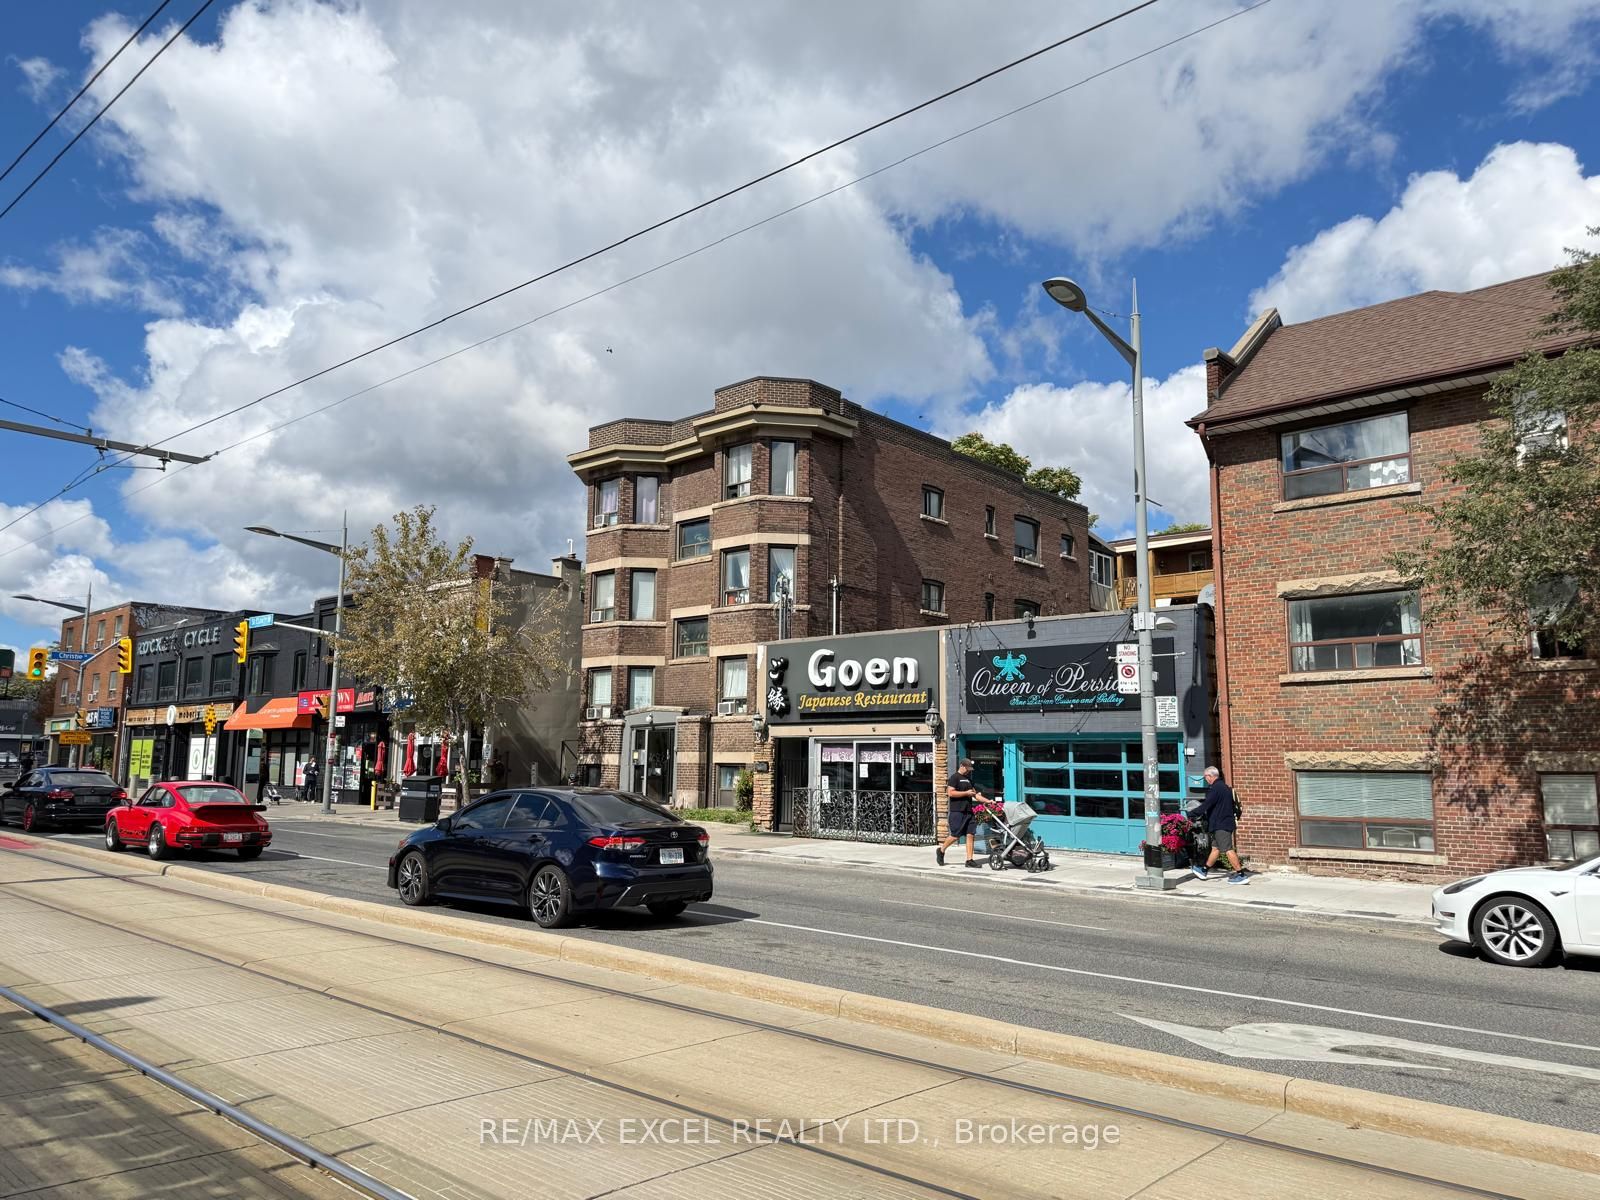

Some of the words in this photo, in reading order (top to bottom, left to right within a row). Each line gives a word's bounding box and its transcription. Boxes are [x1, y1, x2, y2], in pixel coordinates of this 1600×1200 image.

[184, 627, 221, 647] CYCLE
[58, 652, 83, 660] Christie
[808, 648, 919, 688] Goen
[971, 667, 1034, 697] Queen
[1037, 679, 1052, 696] of
[798, 694, 852, 711] Japanese
[855, 691, 927, 708] Restaurant
[1096, 692, 1124, 706] Gallery
